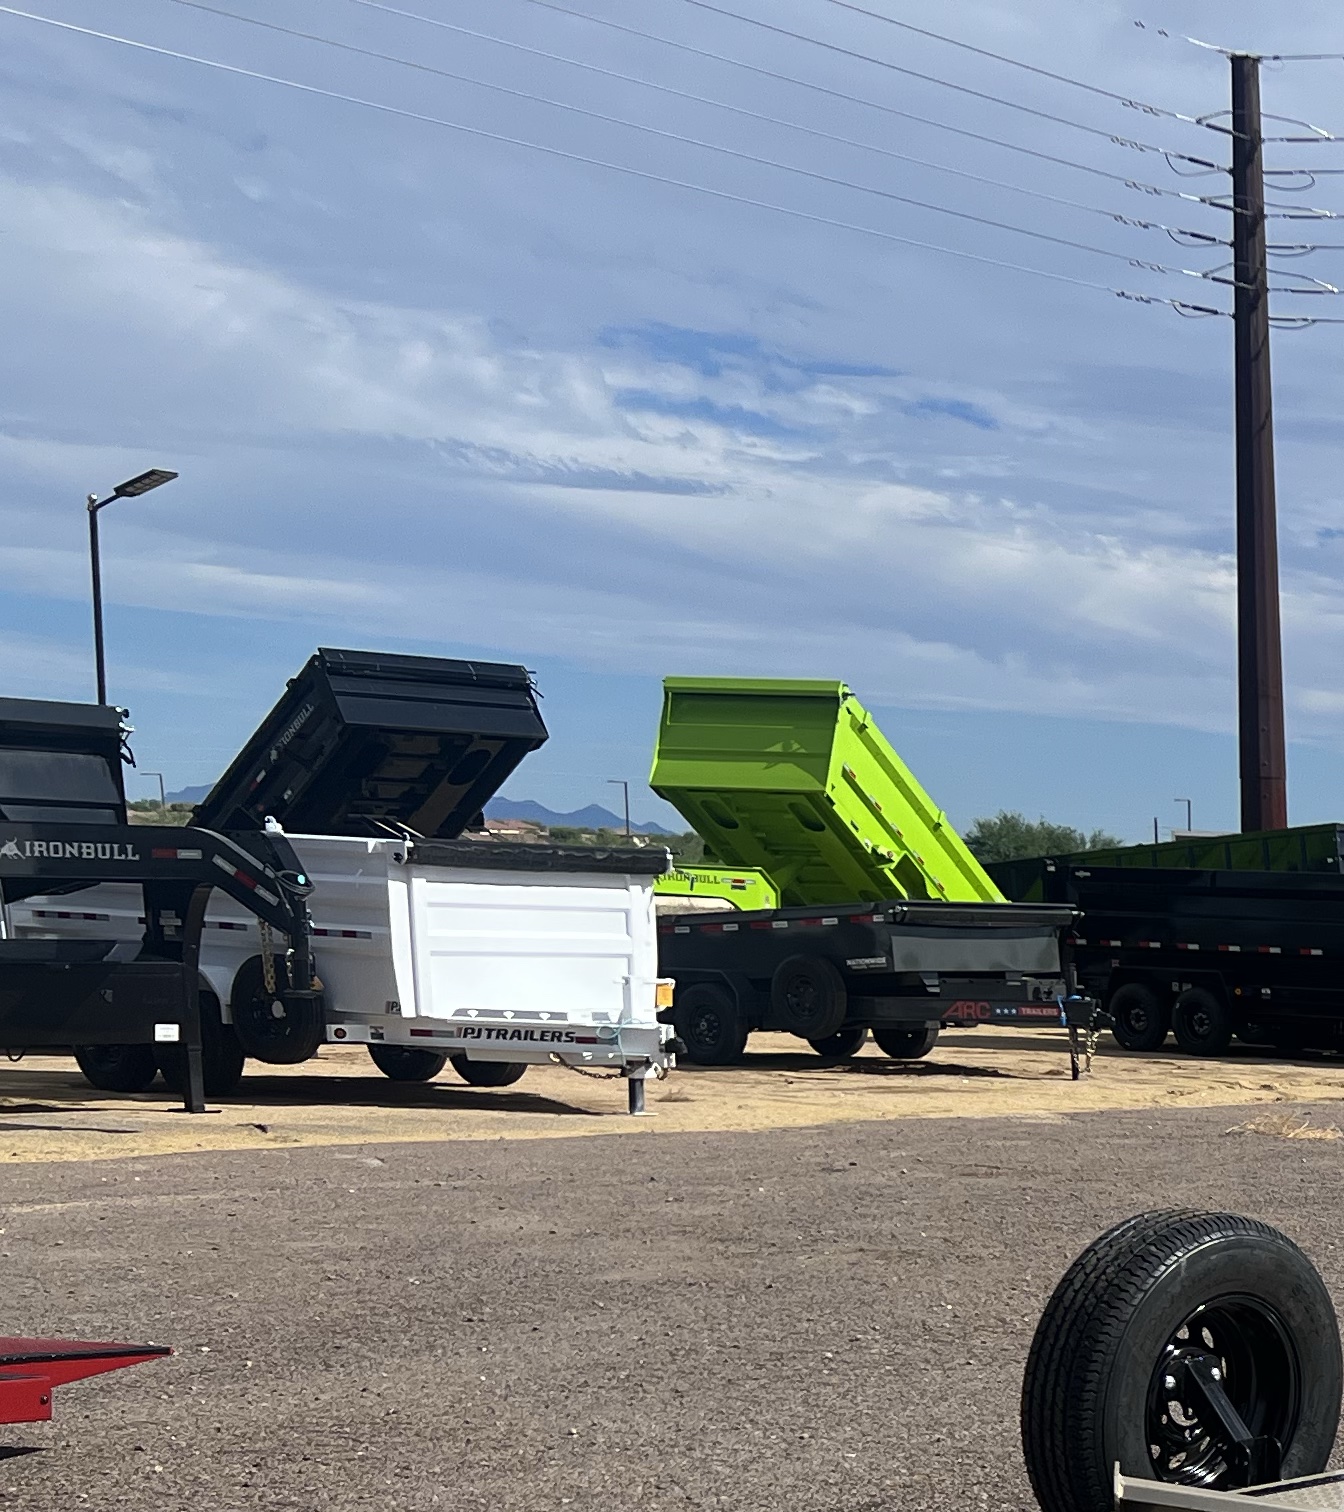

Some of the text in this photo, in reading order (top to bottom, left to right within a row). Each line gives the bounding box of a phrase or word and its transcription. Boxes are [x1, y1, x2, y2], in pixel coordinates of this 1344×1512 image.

[24, 840, 140, 861] IRONBULL
[942, 1001, 1058, 1019] ARC TRAILERS
[484, 1028, 576, 1043] TRAILERS
